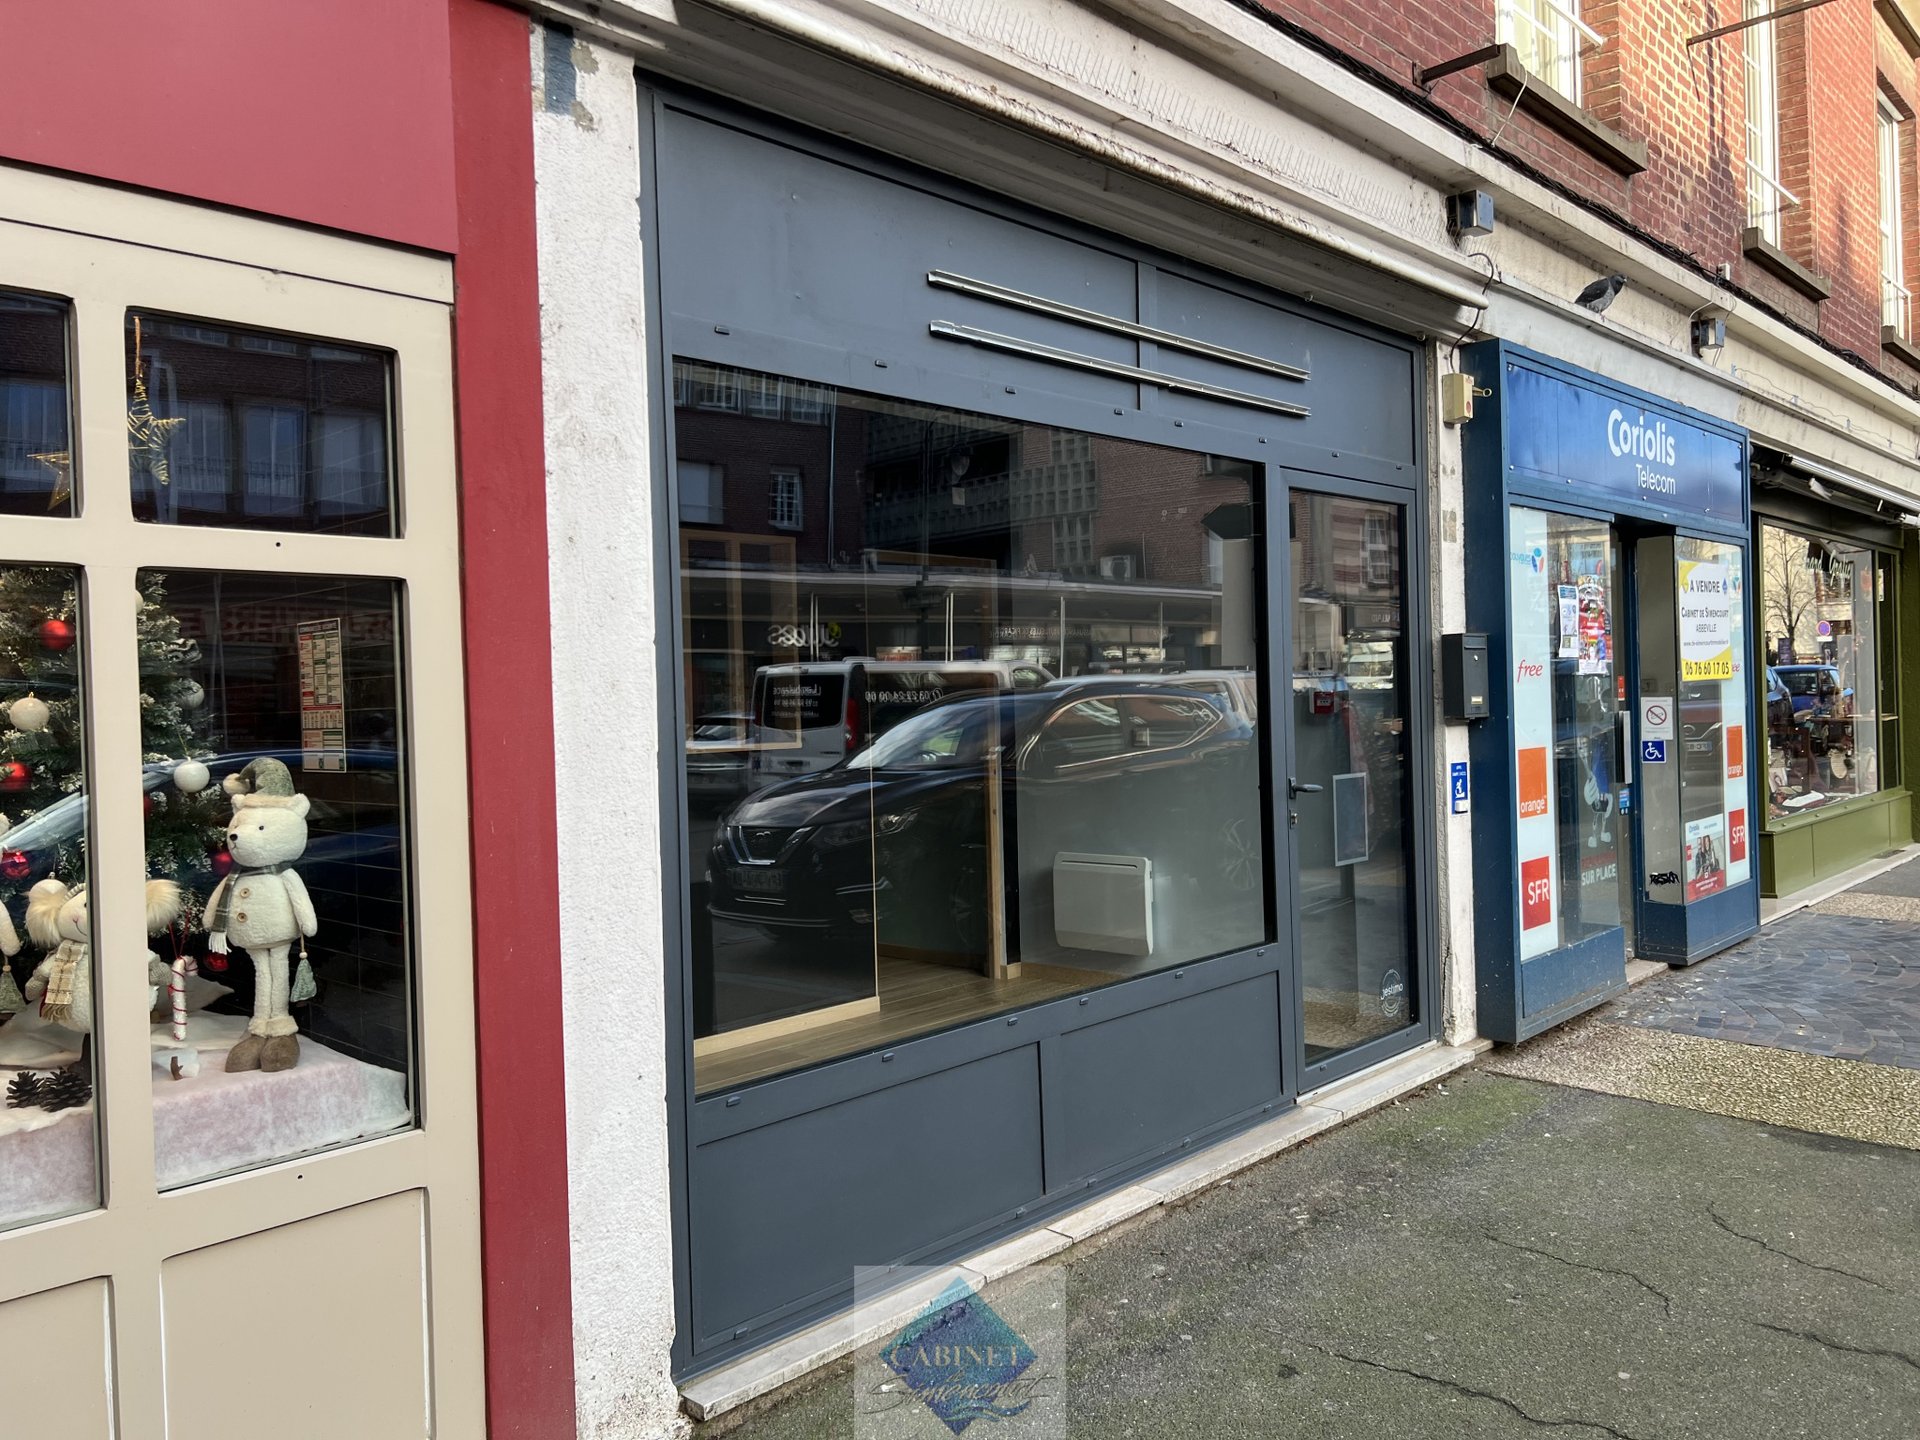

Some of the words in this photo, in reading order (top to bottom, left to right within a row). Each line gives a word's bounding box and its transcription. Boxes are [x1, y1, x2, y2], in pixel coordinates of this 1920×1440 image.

[1608, 409, 1676, 466] Coriolis
[1635, 463, 1676, 495] Telecom
[1689, 580, 1695, 592] A
[1695, 580, 1720, 593] VENDRE
[1517, 659, 1543, 683] free
[1712, 662, 1720, 675] 17
[1721, 662, 1730, 675] 05
[1728, 764, 1742, 776] orange
[1520, 799, 1545, 814] orange
[1731, 825, 1745, 845] SFR
[1581, 869, 1595, 886] SUR
[1596, 863, 1616, 882] PLACE
[1527, 878, 1550, 906] SFR
